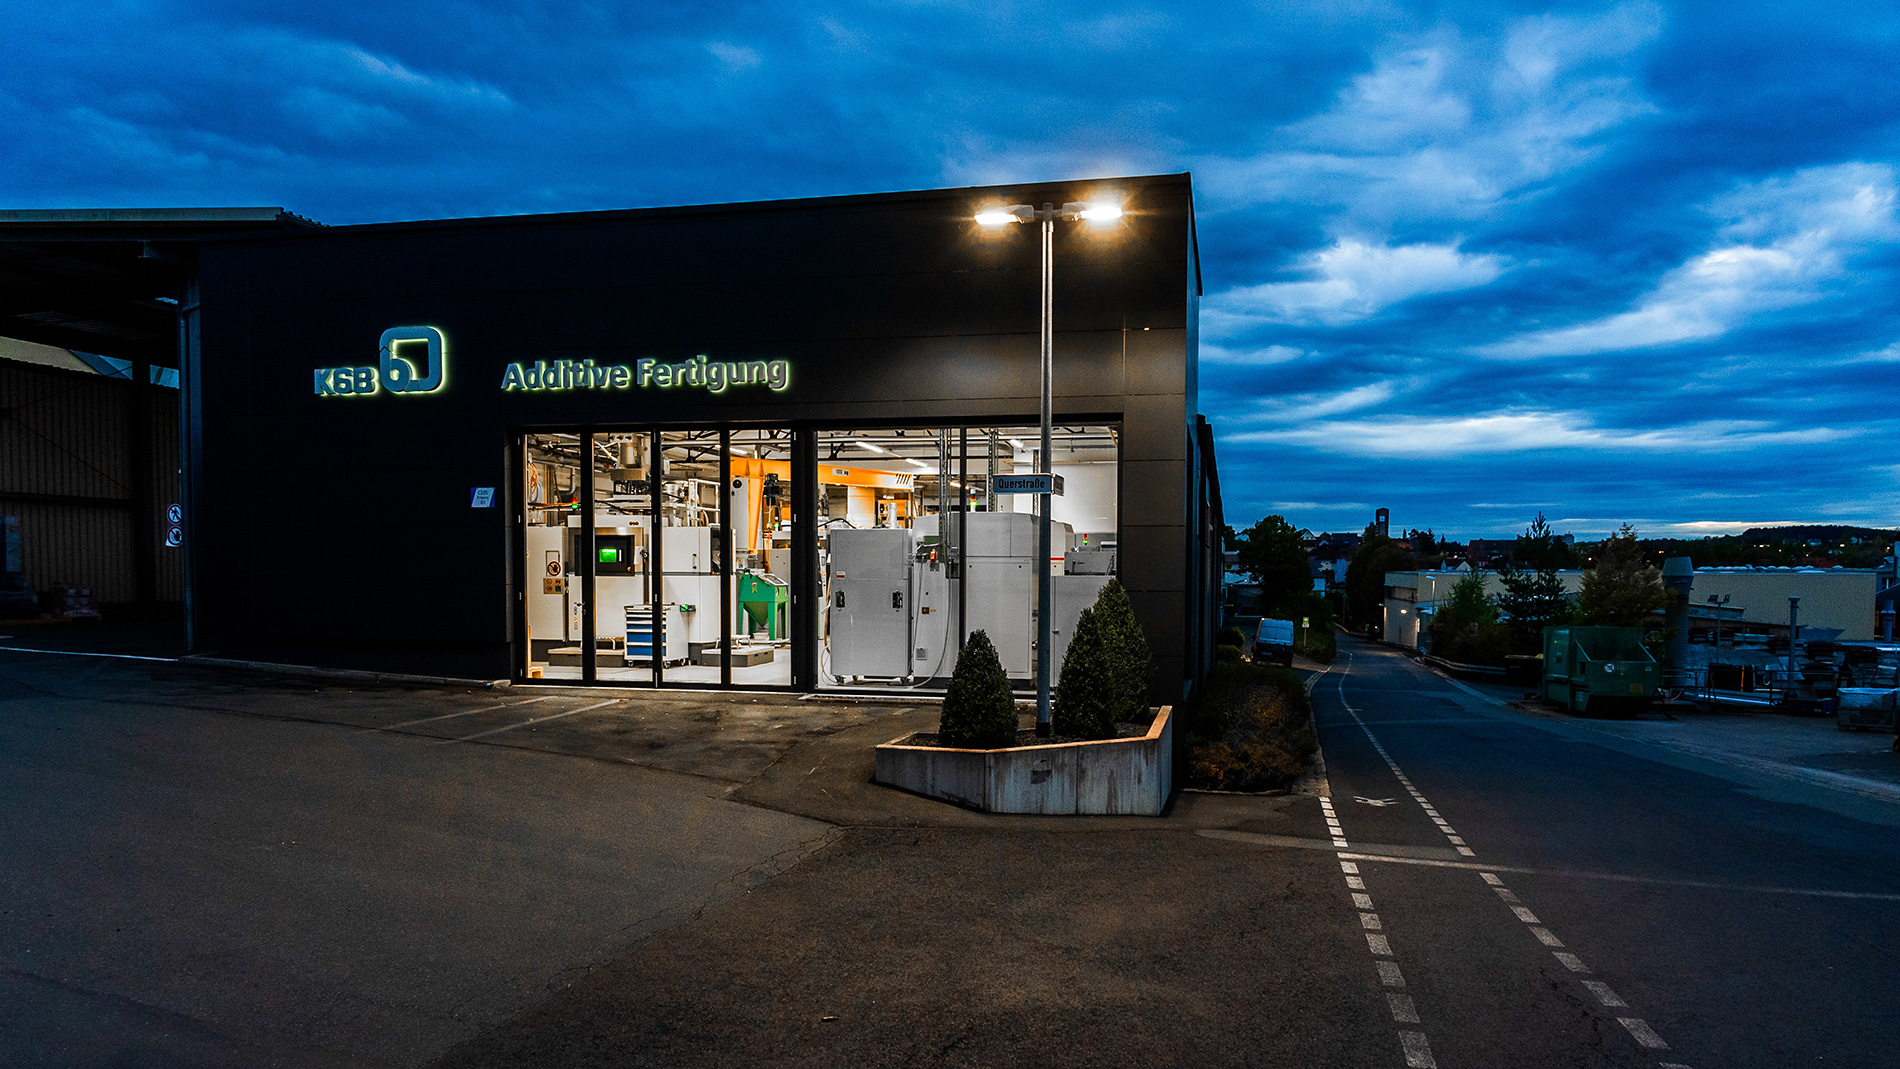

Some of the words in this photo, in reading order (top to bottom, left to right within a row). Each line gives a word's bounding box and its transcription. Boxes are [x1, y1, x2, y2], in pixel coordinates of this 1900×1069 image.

[314, 367, 376, 395] KSB
[501, 360, 631, 390] Additive
[636, 355, 790, 393] Fertigung
[998, 478, 1045, 489] Querstraße
